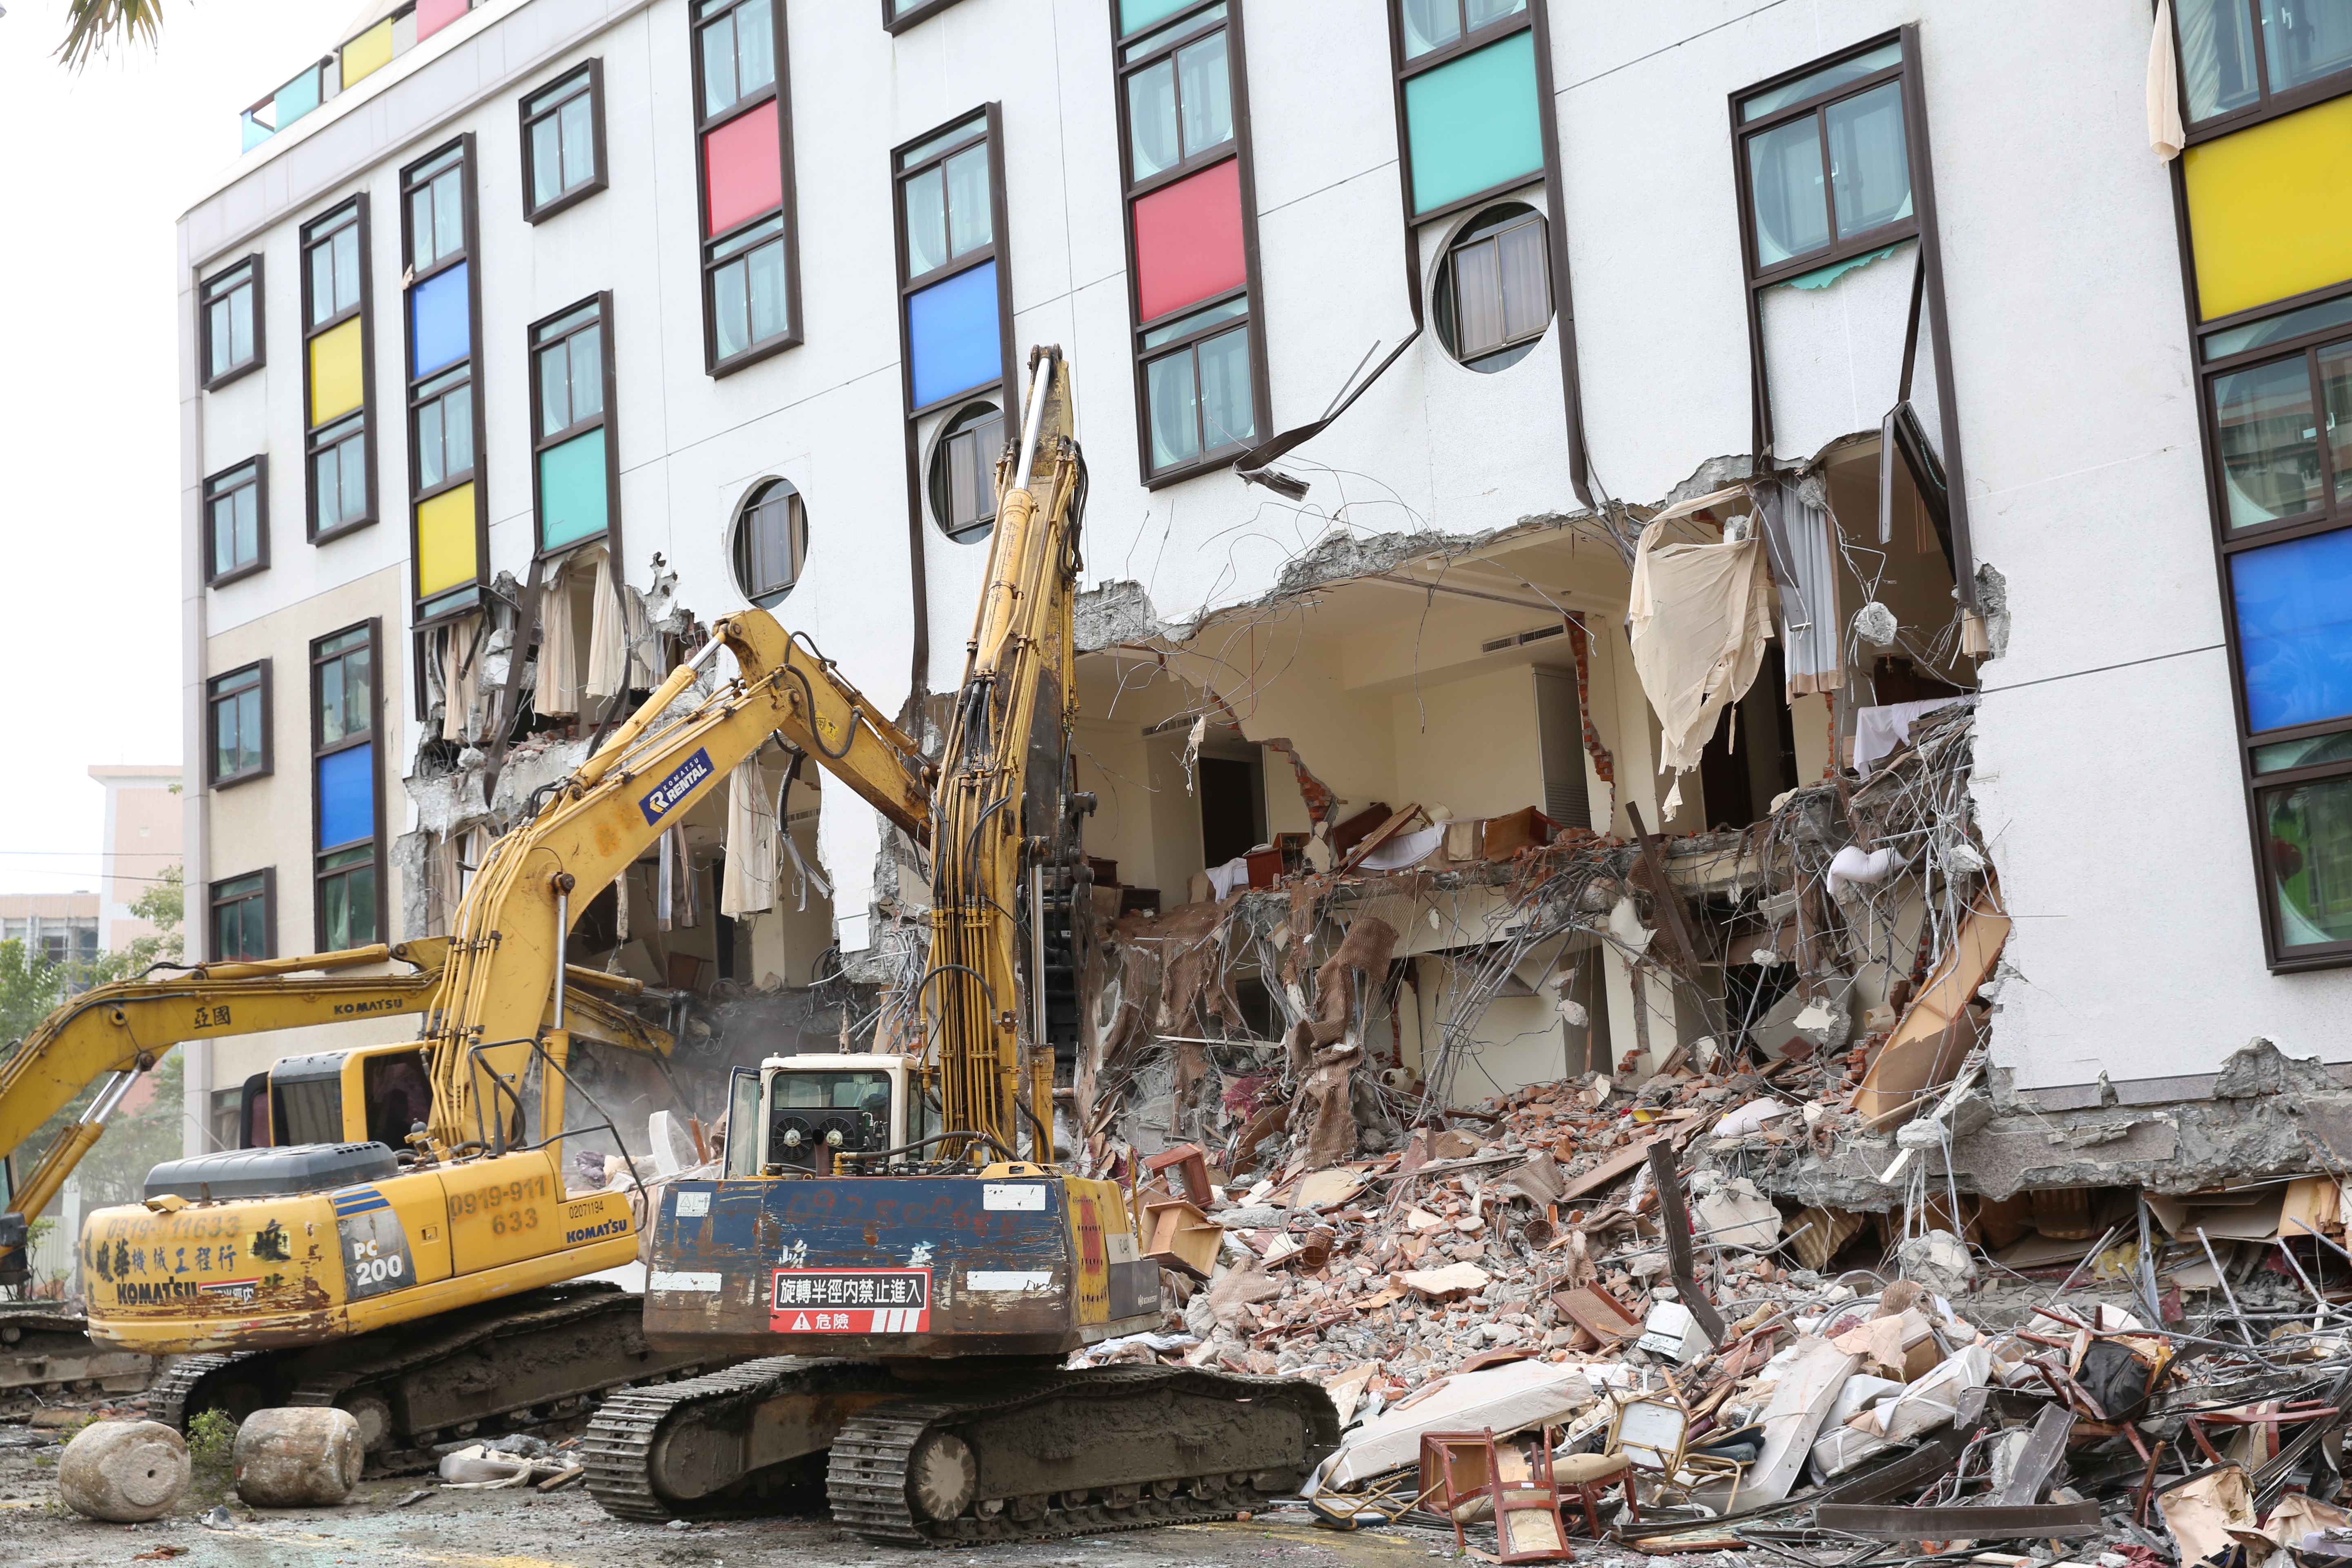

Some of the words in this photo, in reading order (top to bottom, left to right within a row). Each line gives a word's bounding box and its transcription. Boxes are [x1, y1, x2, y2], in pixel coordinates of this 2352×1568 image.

[663, 757, 699, 791] KOMATSU
[666, 764, 707, 802] RENTAL
[194, 1005, 231, 1029] 亞國
[334, 999, 403, 1015] KOMATSU
[450, 1176, 546, 1217] 0919-911
[492, 1208, 539, 1236] 633
[569, 1200, 604, 1219] 02071194
[566, 1218, 628, 1243] KOMATSU
[354, 1239, 378, 1260] PC
[356, 1254, 403, 1286] 200
[815, 1313, 849, 1330] 危險
